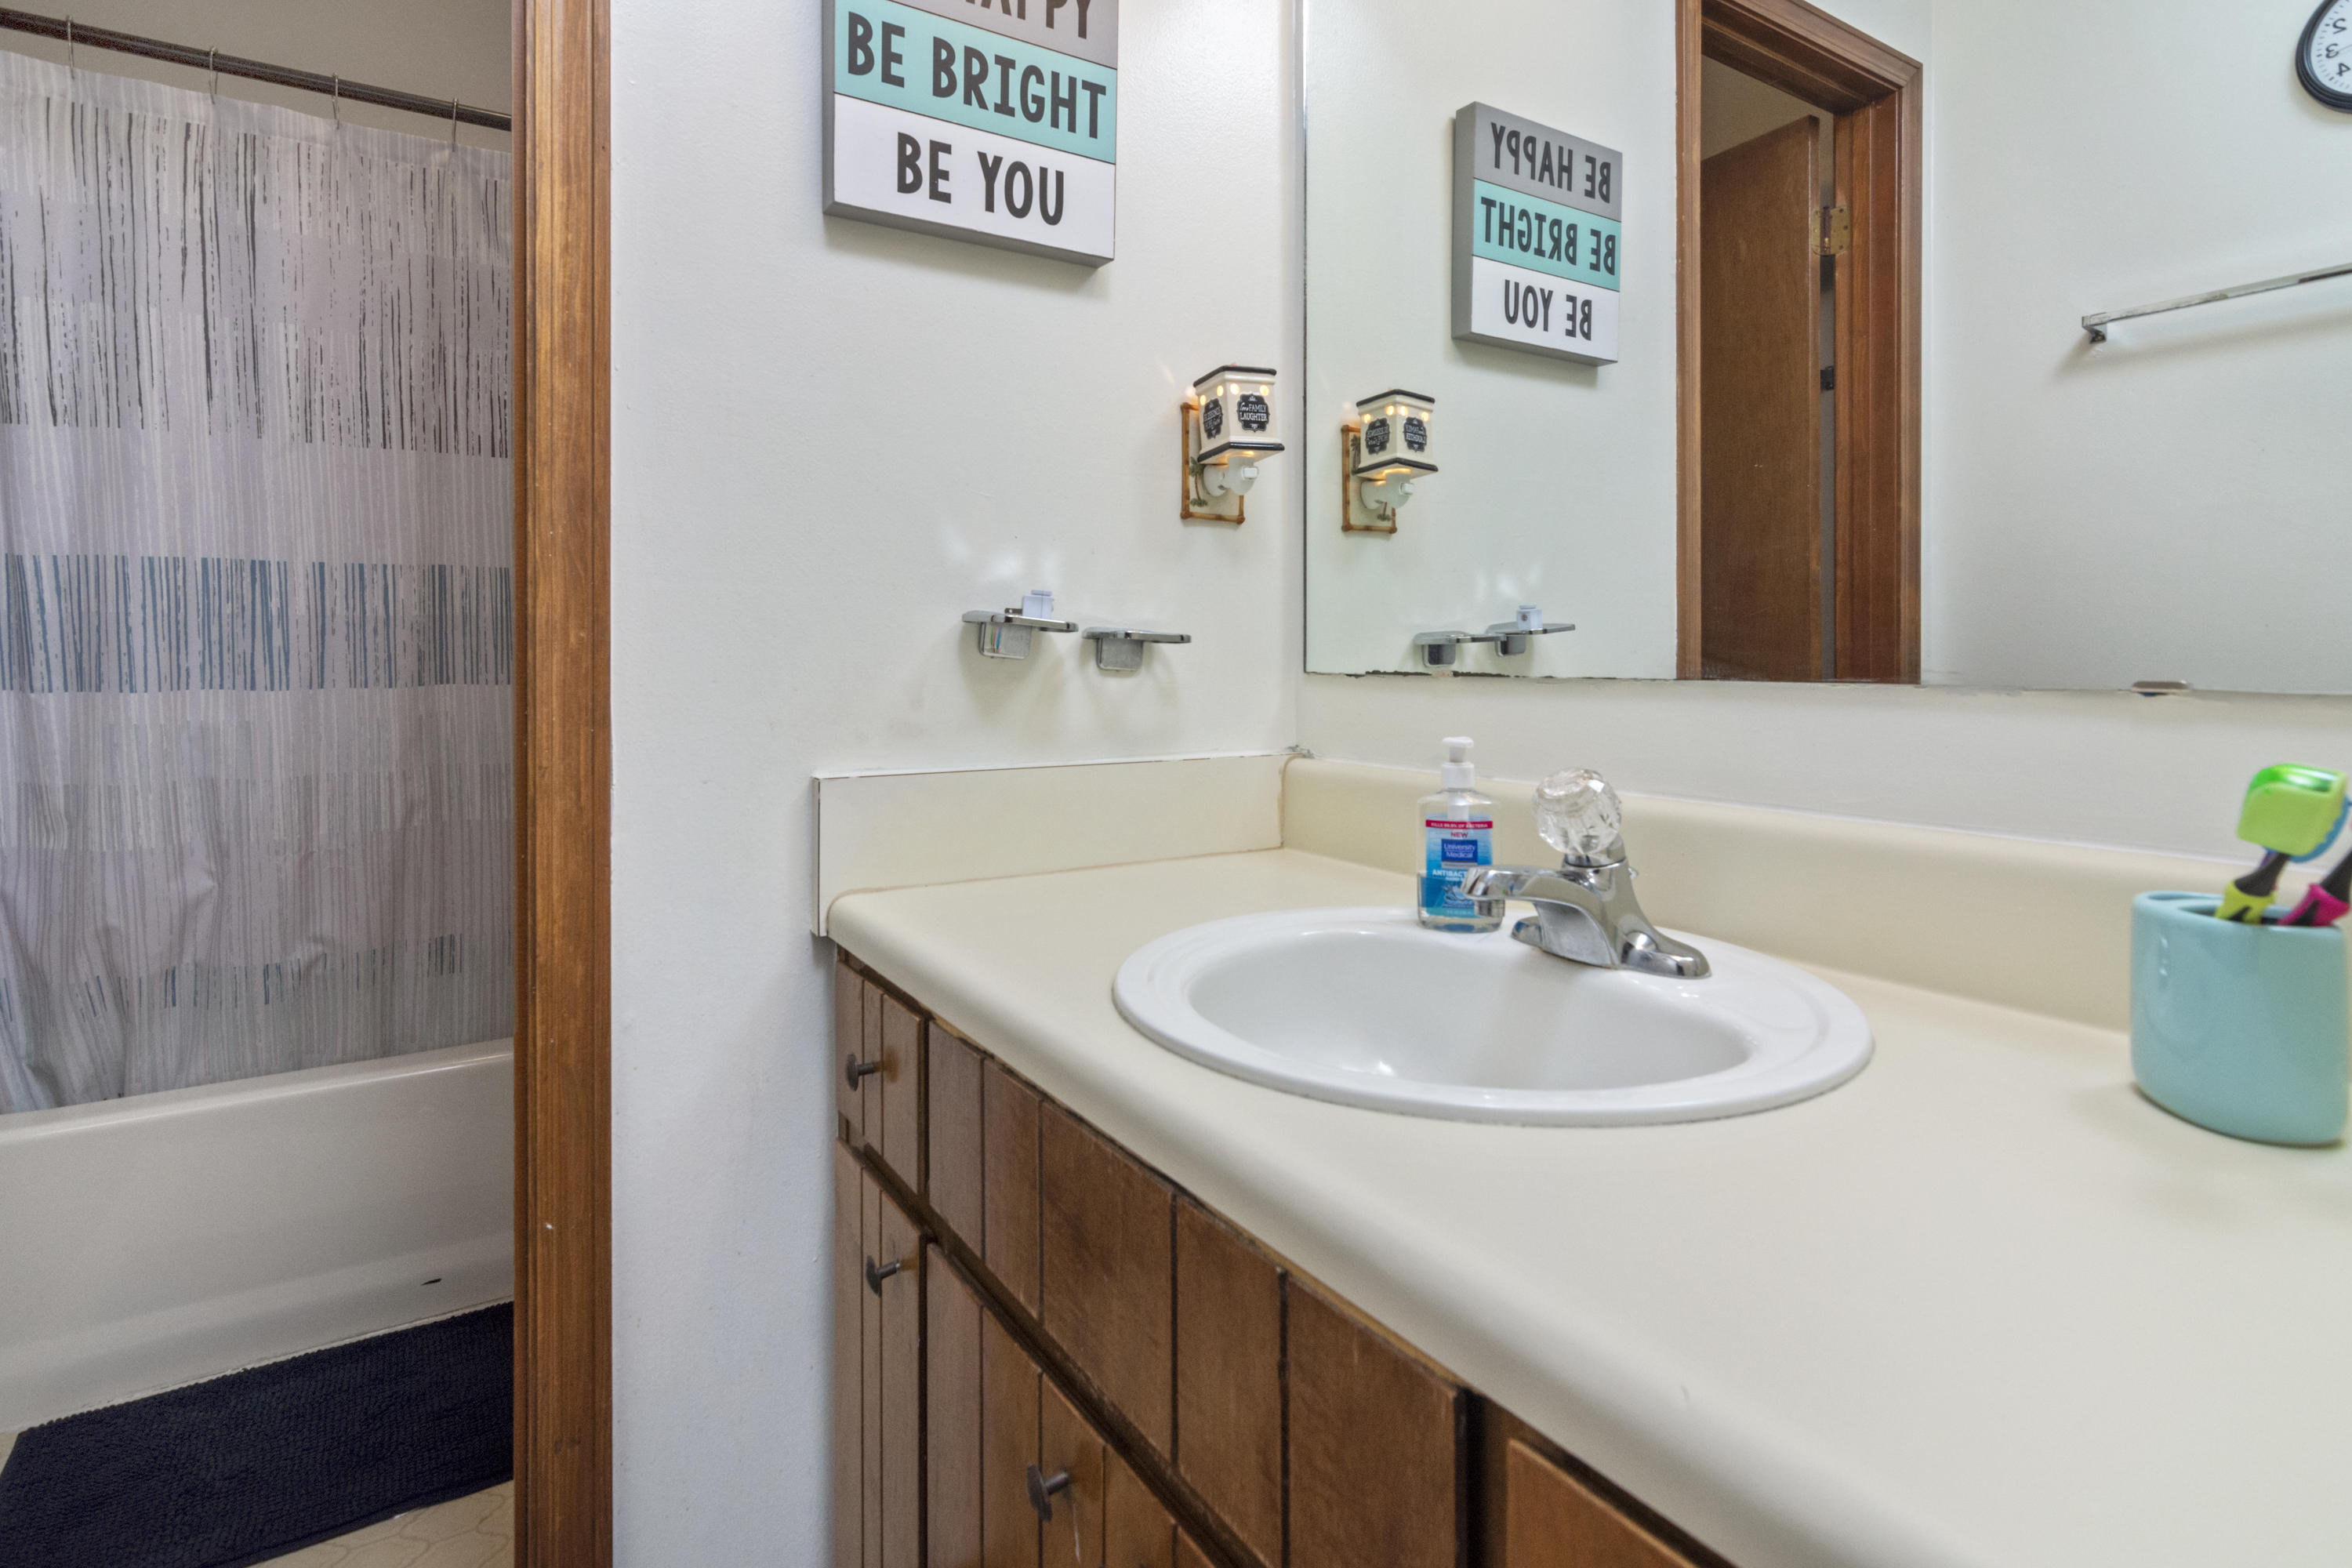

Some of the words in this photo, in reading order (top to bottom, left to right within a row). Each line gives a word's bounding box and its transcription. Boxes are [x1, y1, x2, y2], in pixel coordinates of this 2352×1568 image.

[848, 11, 905, 88] BE
[932, 36, 1106, 139] BRIGHT
[898, 132, 952, 204] BE
[978, 151, 1064, 226] YOU
[1248, 404, 1267, 412] FAMILY
[1240, 412, 1268, 421] LAUGHTER
[1444, 843, 1475, 852] University
